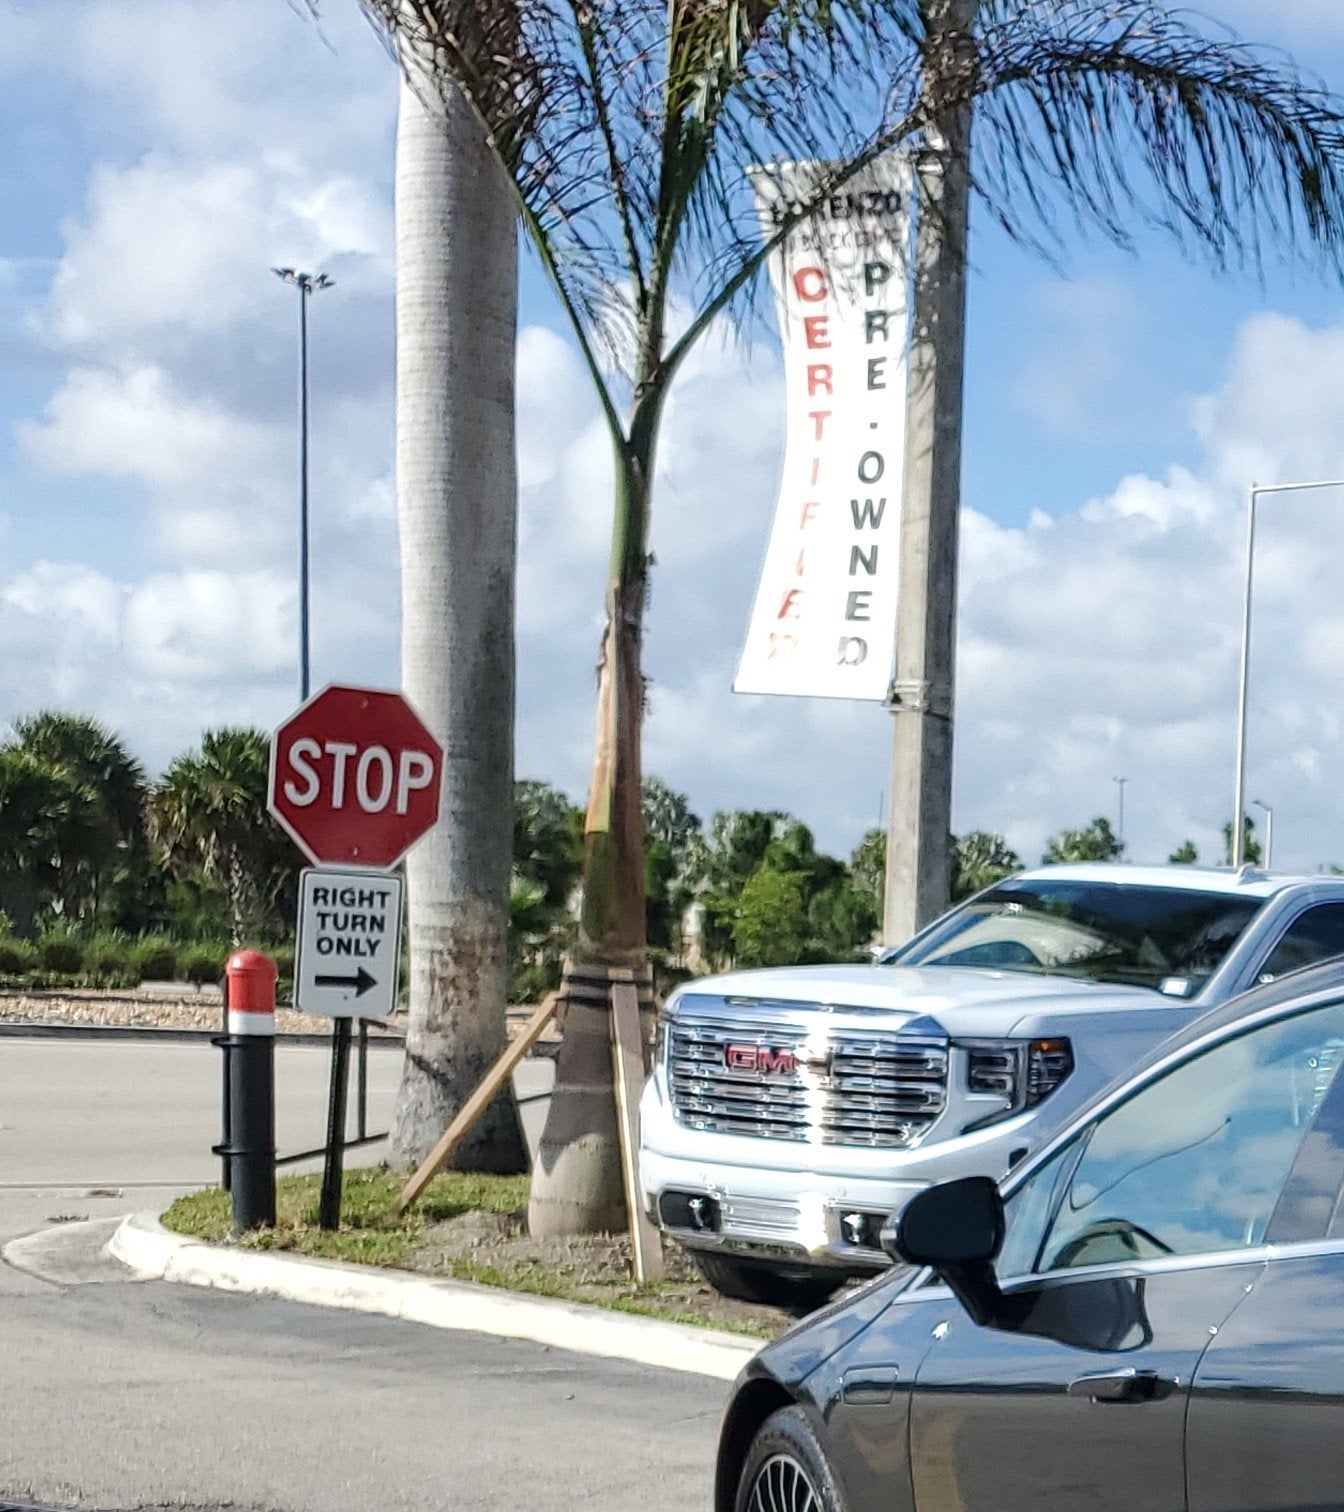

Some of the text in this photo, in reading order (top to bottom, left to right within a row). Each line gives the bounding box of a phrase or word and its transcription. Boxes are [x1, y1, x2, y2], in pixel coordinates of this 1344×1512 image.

[284, 737, 434, 816] STOP
[312, 886, 391, 909] RIGHT
[316, 911, 385, 933] TURN
[316, 937, 382, 958] ONLY
